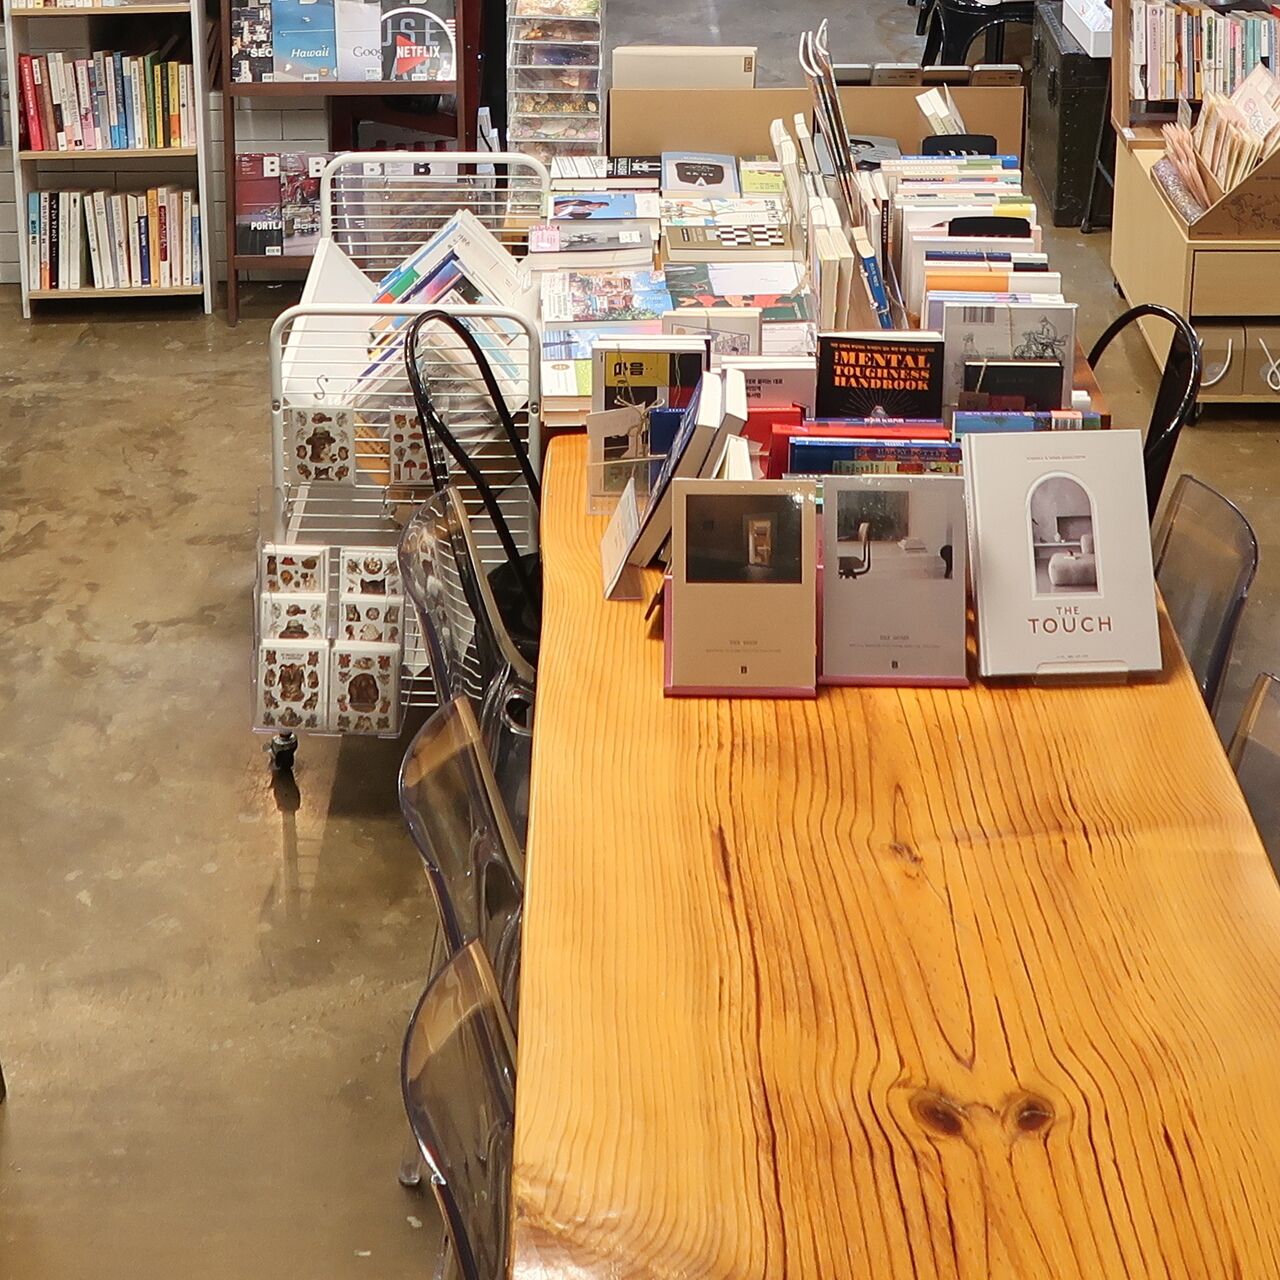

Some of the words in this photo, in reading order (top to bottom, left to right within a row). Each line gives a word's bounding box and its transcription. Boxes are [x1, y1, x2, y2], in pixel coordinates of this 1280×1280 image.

[291, 45, 330, 58] Hawaii
[396, 46, 441, 59] NETFLIX
[263, 156, 280, 177] B
[839, 350, 930, 368] MENTAL
[833, 365, 930, 379] TOUGHNESS
[833, 375, 929, 391] HANDBOOK
[877, 447, 907, 456] HARRY
[910, 447, 947, 456] POTTER
[1056, 606, 1080, 616] THE
[1028, 616, 1113, 634] TOUCH
